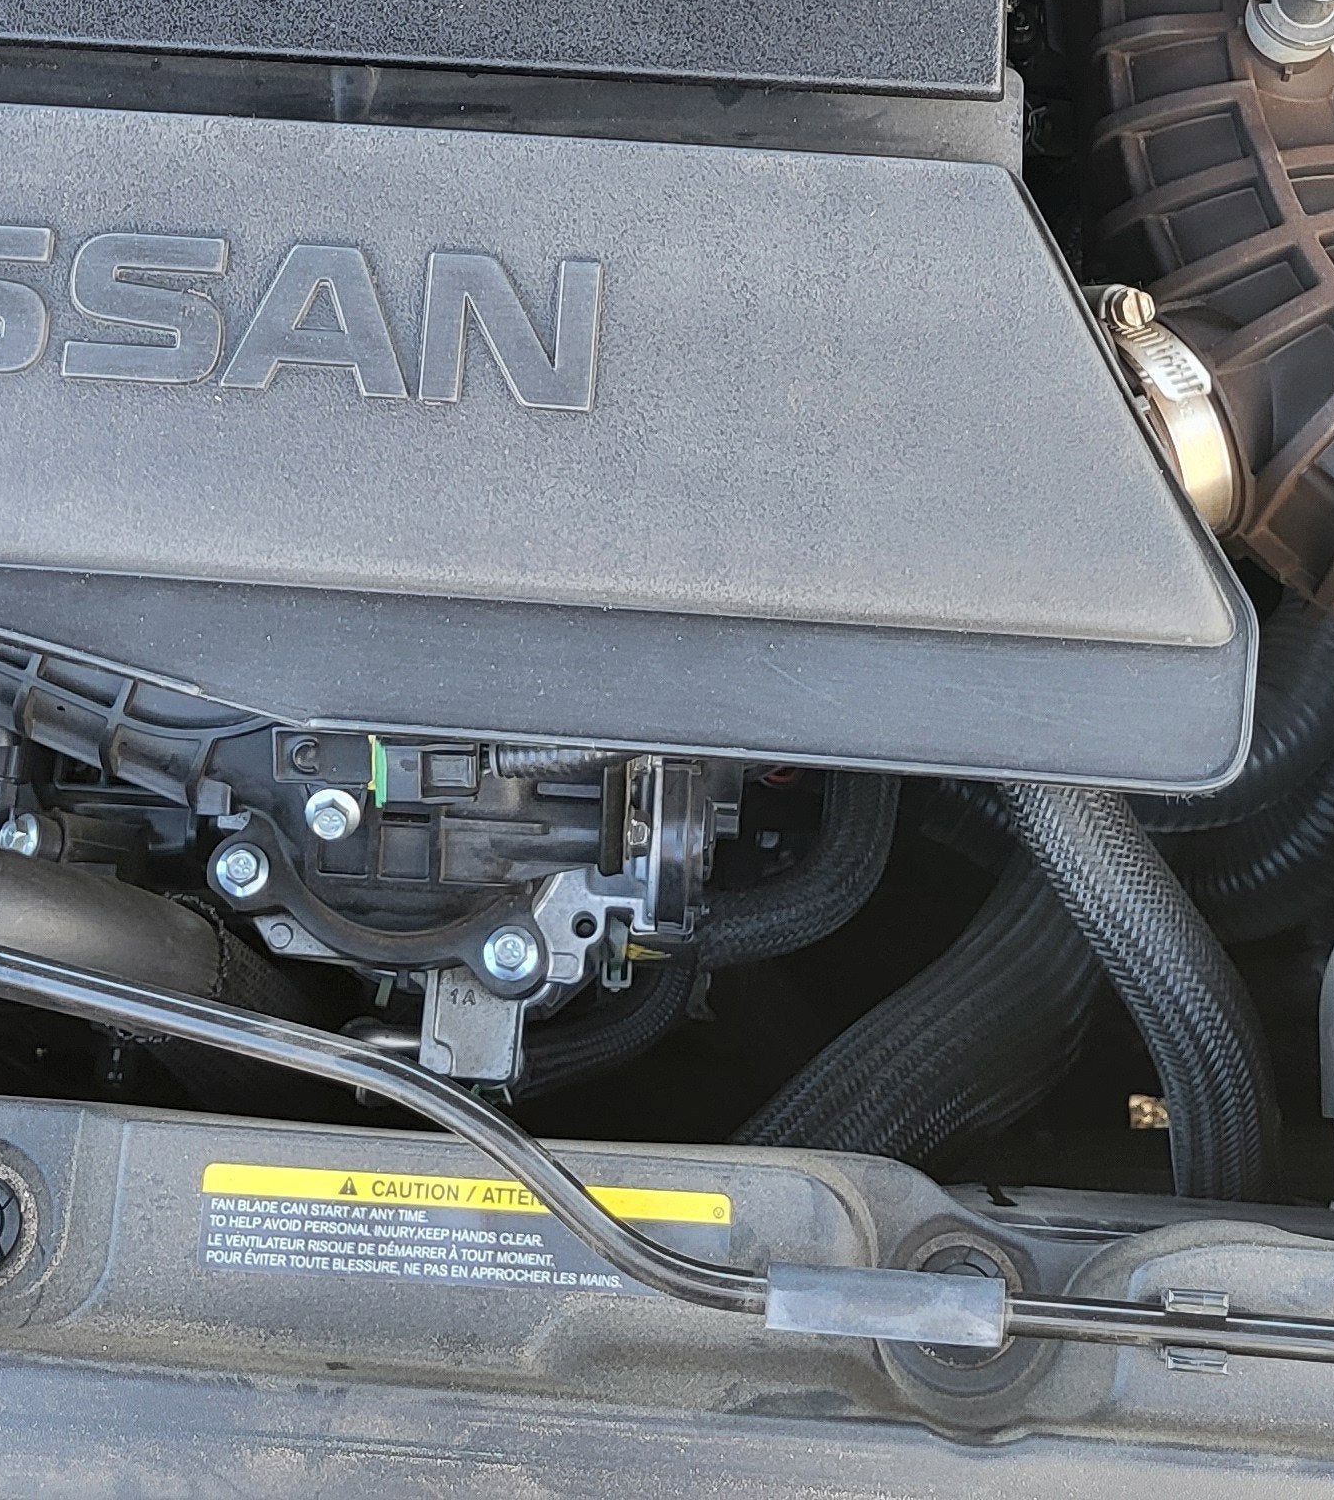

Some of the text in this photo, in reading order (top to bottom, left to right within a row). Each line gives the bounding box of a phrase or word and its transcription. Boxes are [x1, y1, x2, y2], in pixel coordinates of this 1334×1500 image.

[371, 1180, 460, 1201] CAUTION
[210, 1198, 429, 1223] FAN BLADE CAN START AT ANY TIME.
[209, 1214, 226, 1228] TO
[229, 1215, 261, 1230] HELP
[263, 1217, 302, 1231] AVOID
[304, 1220, 371, 1237] PERSONAL
[452, 1229, 497, 1244] HANDS
[499, 1232, 544, 1248] CLEAR.
[207, 1233, 222, 1247] LE
[307, 1238, 355, 1256] RISQUE
[357, 1243, 375, 1256] DE
[377, 1241, 448, 1260] DÉMARRER
[449, 1244, 458, 1260] À
[460, 1248, 494, 1263] TOUT
[496, 1252, 556, 1269] MOMENT.
[206, 1249, 624, 1289] POUR ÉVITER TOUTE BLESSURE, NE PAS EN APPROCHER LES MAINS.
